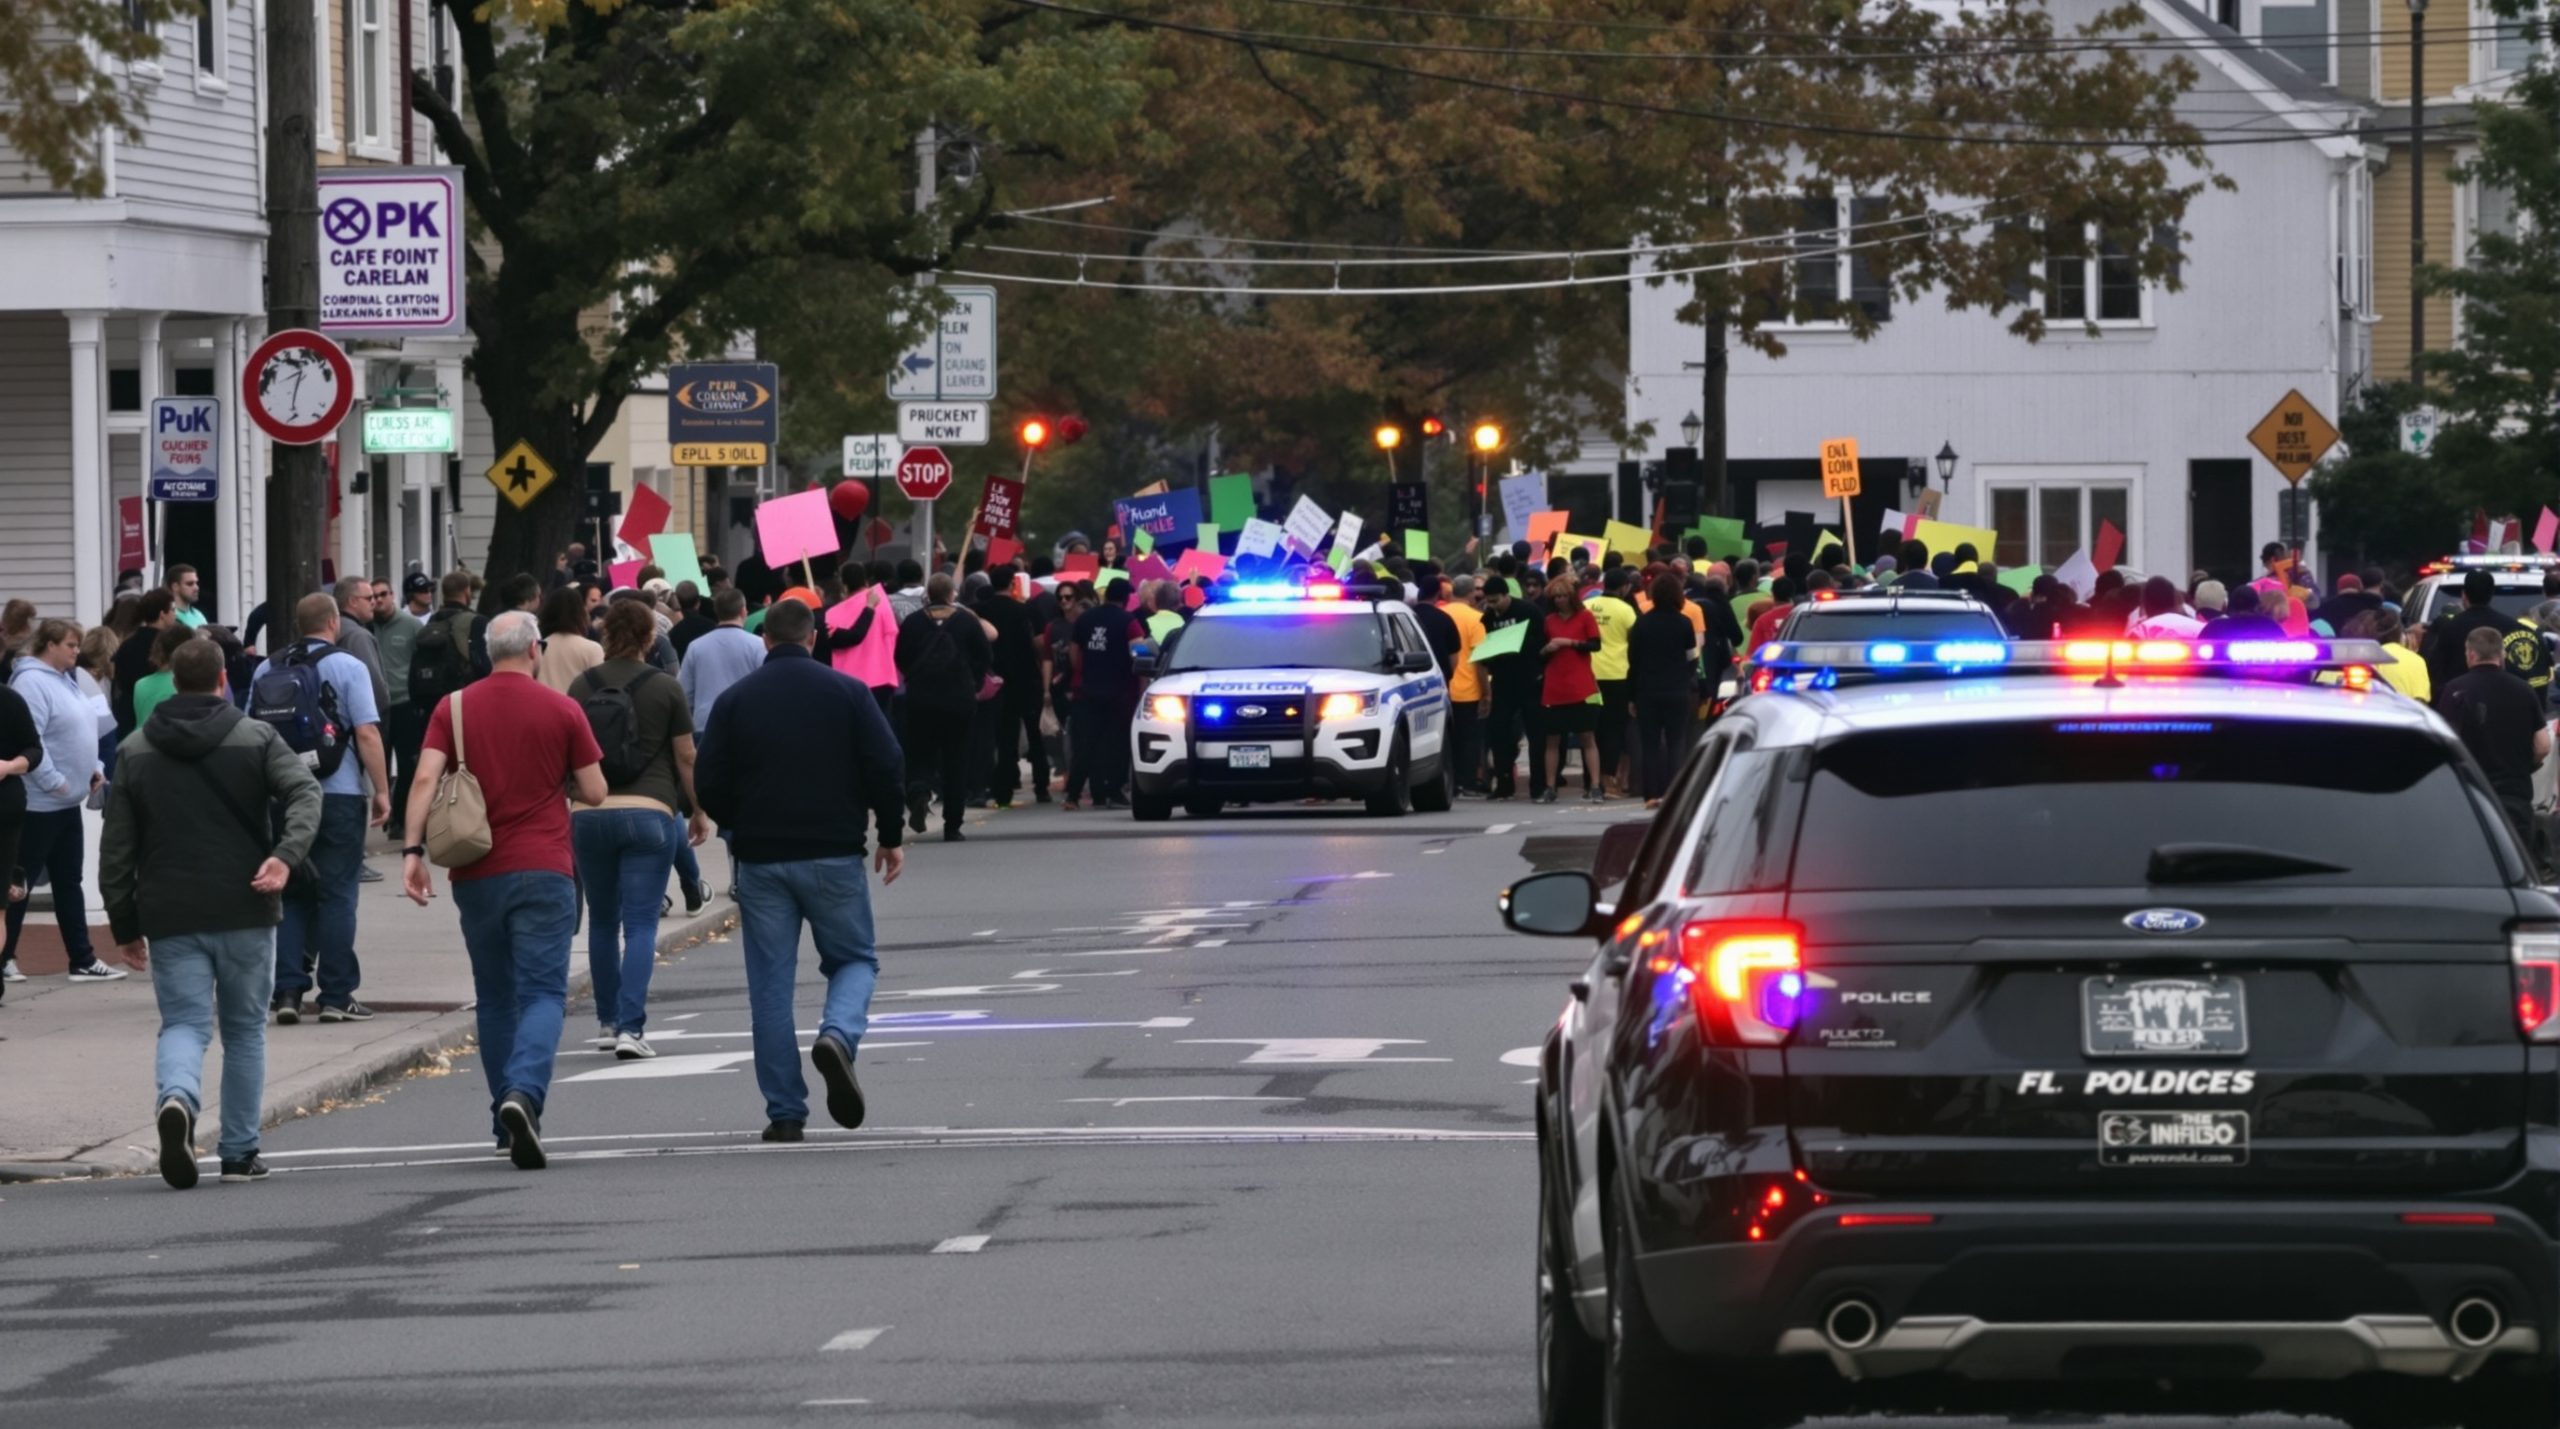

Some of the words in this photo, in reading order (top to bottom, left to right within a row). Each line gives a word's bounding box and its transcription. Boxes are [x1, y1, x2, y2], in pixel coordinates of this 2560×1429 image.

[330, 249, 377, 266] CAFE
[382, 248, 438, 265] FOINT
[343, 269, 429, 286] CARELAN
[159, 406, 211, 432] PuK
[902, 463, 945, 484] STOP
[1841, 991, 1932, 1004] POLICE
[2017, 1070, 2063, 1095] FL.
[2084, 1070, 2256, 1095] POLDICES
